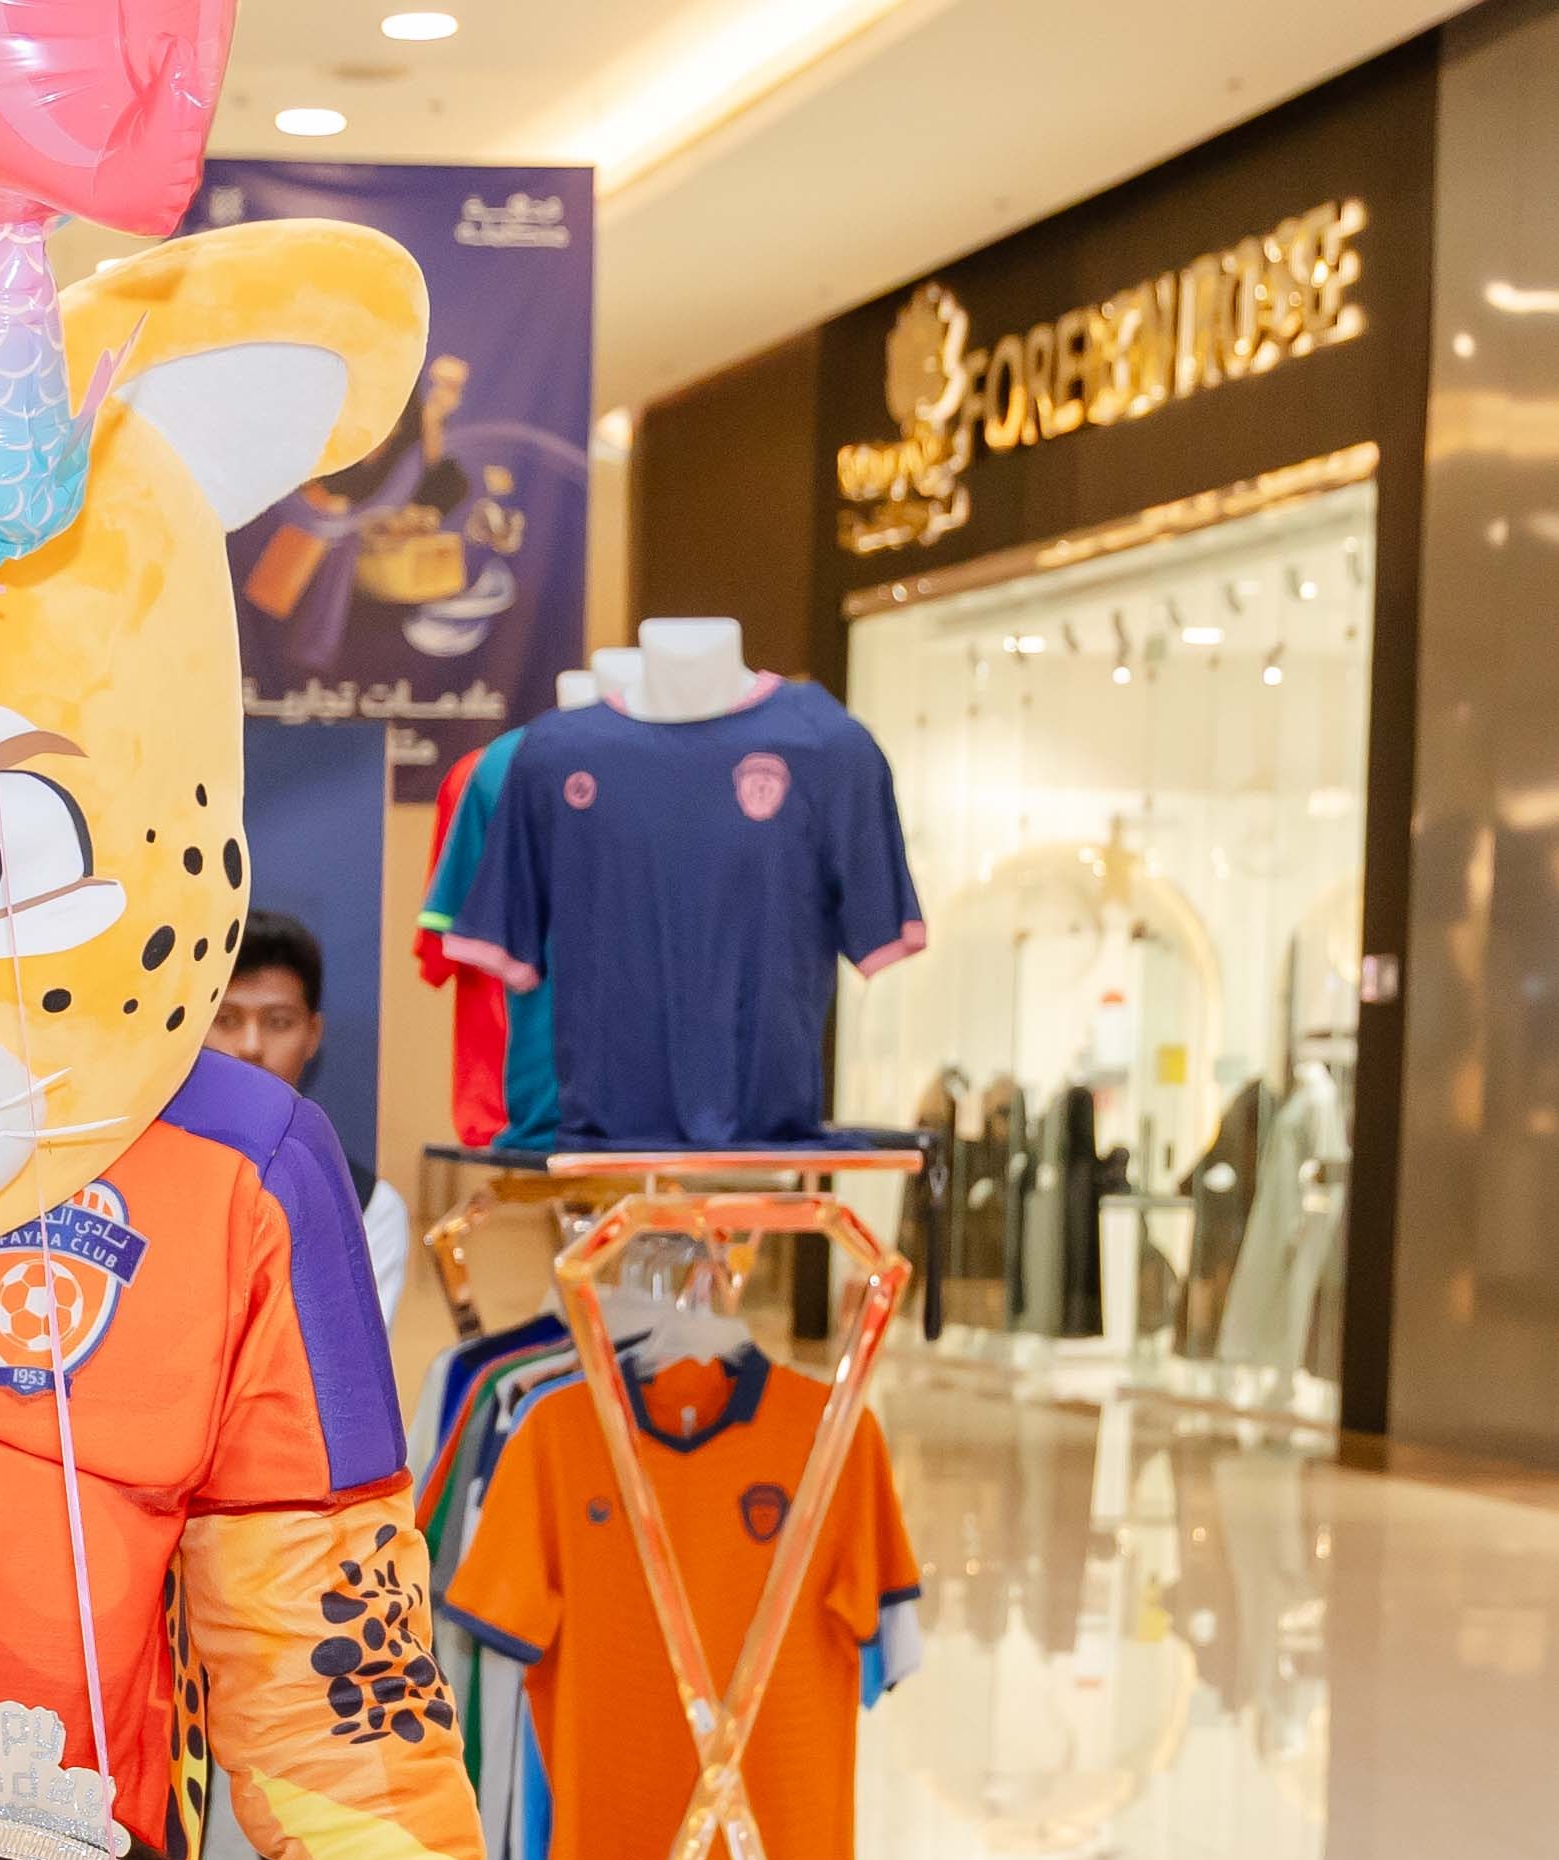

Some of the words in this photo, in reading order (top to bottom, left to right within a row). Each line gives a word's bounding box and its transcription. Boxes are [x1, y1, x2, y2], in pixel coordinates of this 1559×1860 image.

[75, 1216, 131, 1250] نادي
[70, 1237, 119, 1269] CLUB
[12, 1368, 47, 1387] 1953
